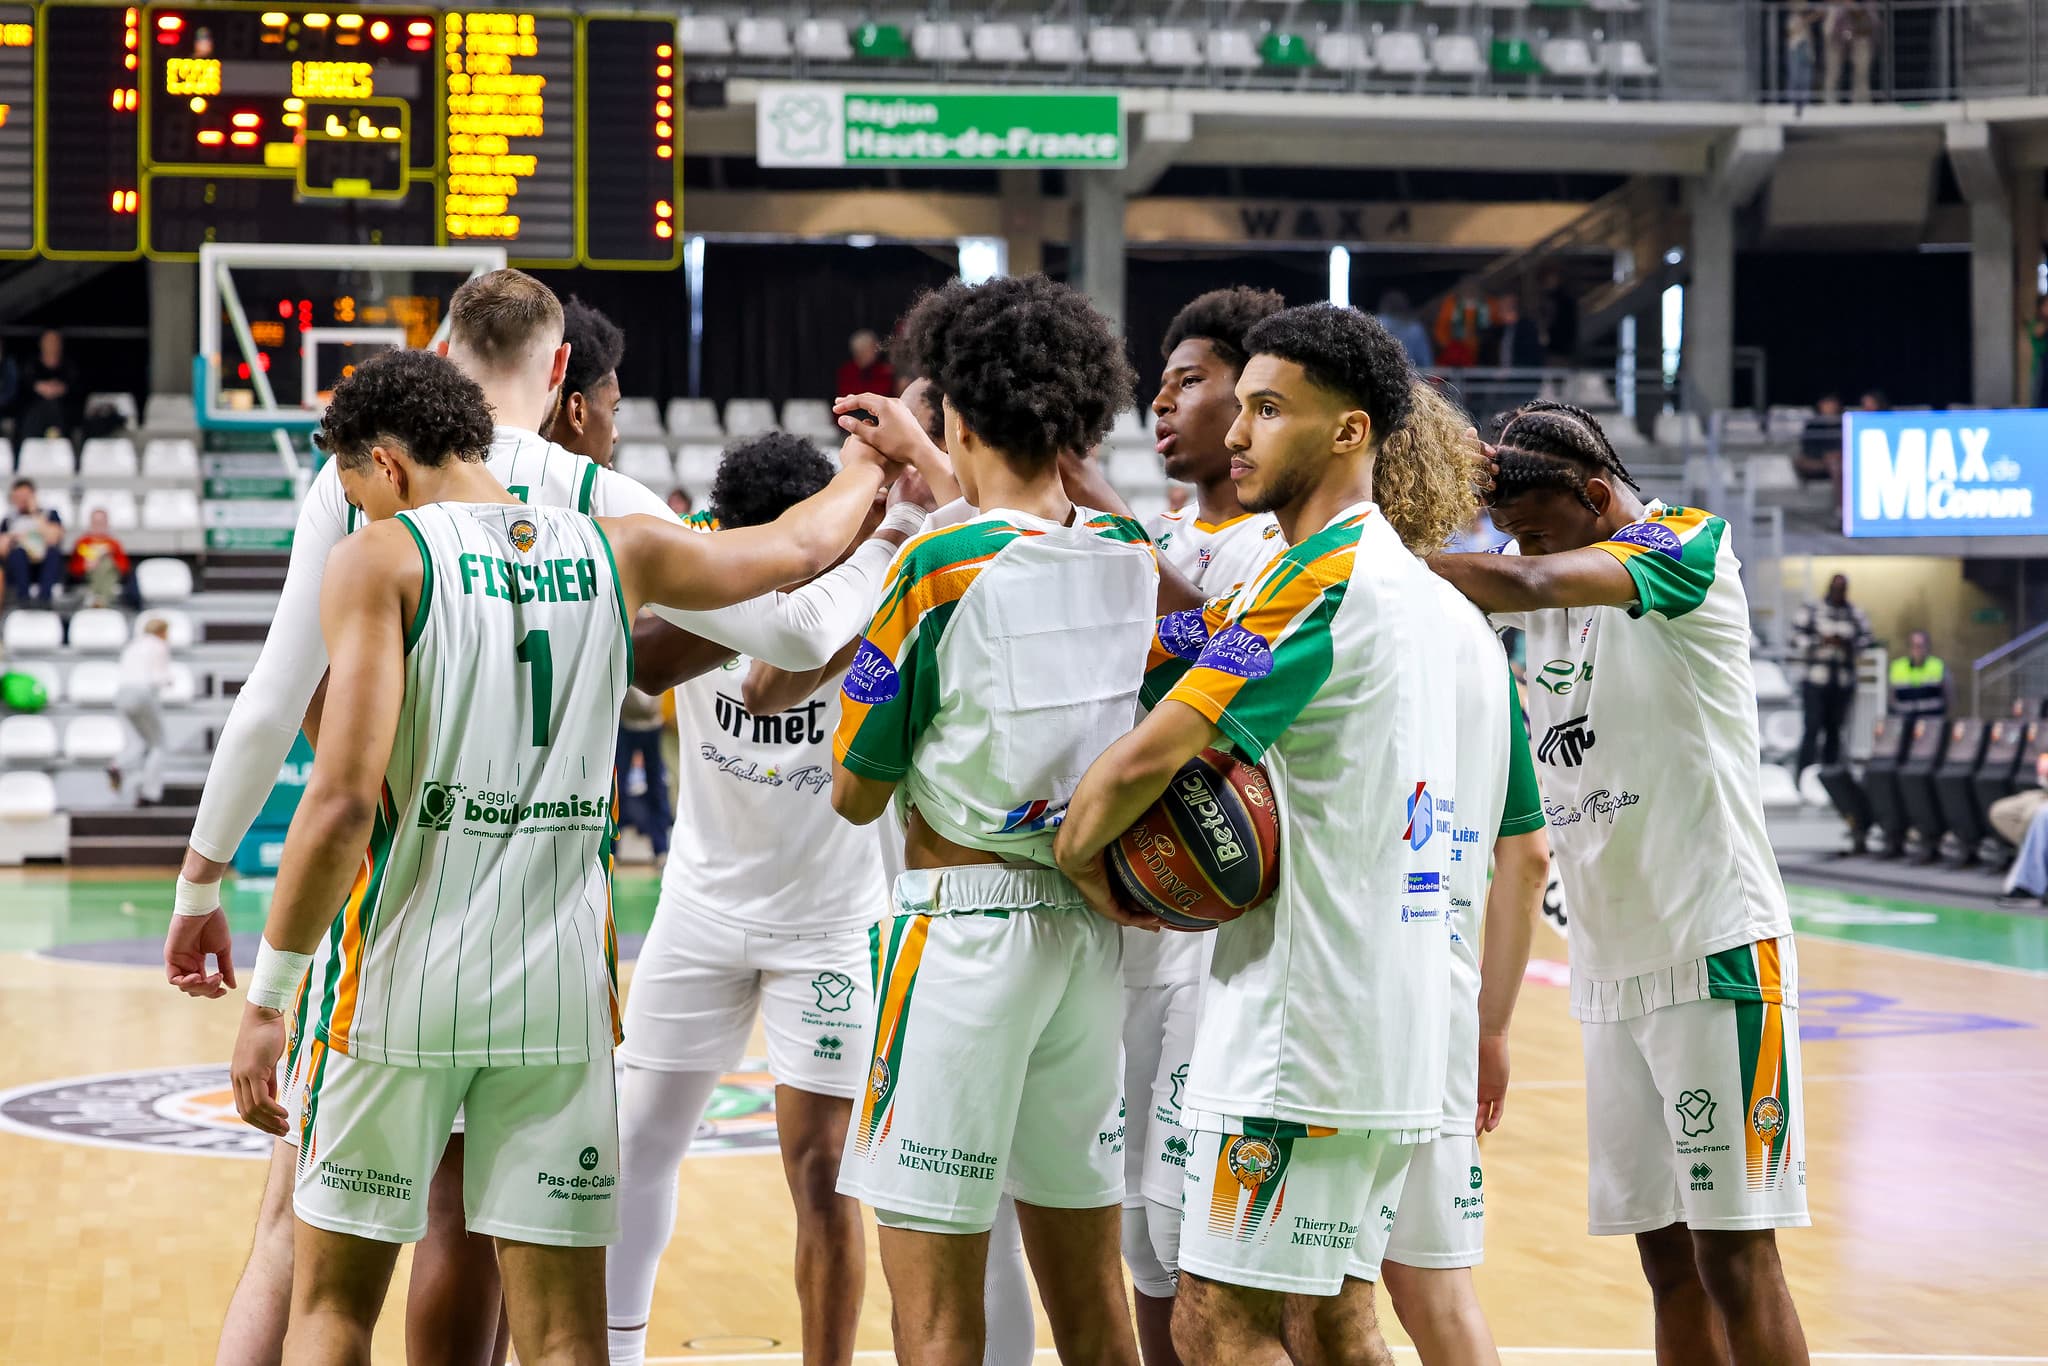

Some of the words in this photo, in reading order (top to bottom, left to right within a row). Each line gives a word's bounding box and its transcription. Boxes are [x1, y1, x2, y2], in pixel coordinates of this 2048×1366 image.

[848, 98, 938, 128] Région
[848, 127, 1118, 159] Hauts-de-France
[1859, 427, 1990, 520] MAX
[1927, 482, 2033, 519] Comm
[458, 552, 598, 605] FISCHER
[1212, 648, 1248, 666] Portel
[1228, 630, 1269, 657] Mer
[858, 651, 895, 681] Mer
[516, 629, 554, 747] 1
[1182, 776, 1242, 863] Betclic
[901, 1138, 948, 1160] Thierry
[951, 1148, 998, 1165] Dandre
[320, 1161, 363, 1180] Thierry
[367, 1169, 413, 1186] Dandre
[898, 1153, 995, 1180] MENUISERIE
[320, 1173, 411, 1201] MENUISERIE
[1294, 1216, 1336, 1234] Thierry
[1291, 1232, 1355, 1249] MENUISE
